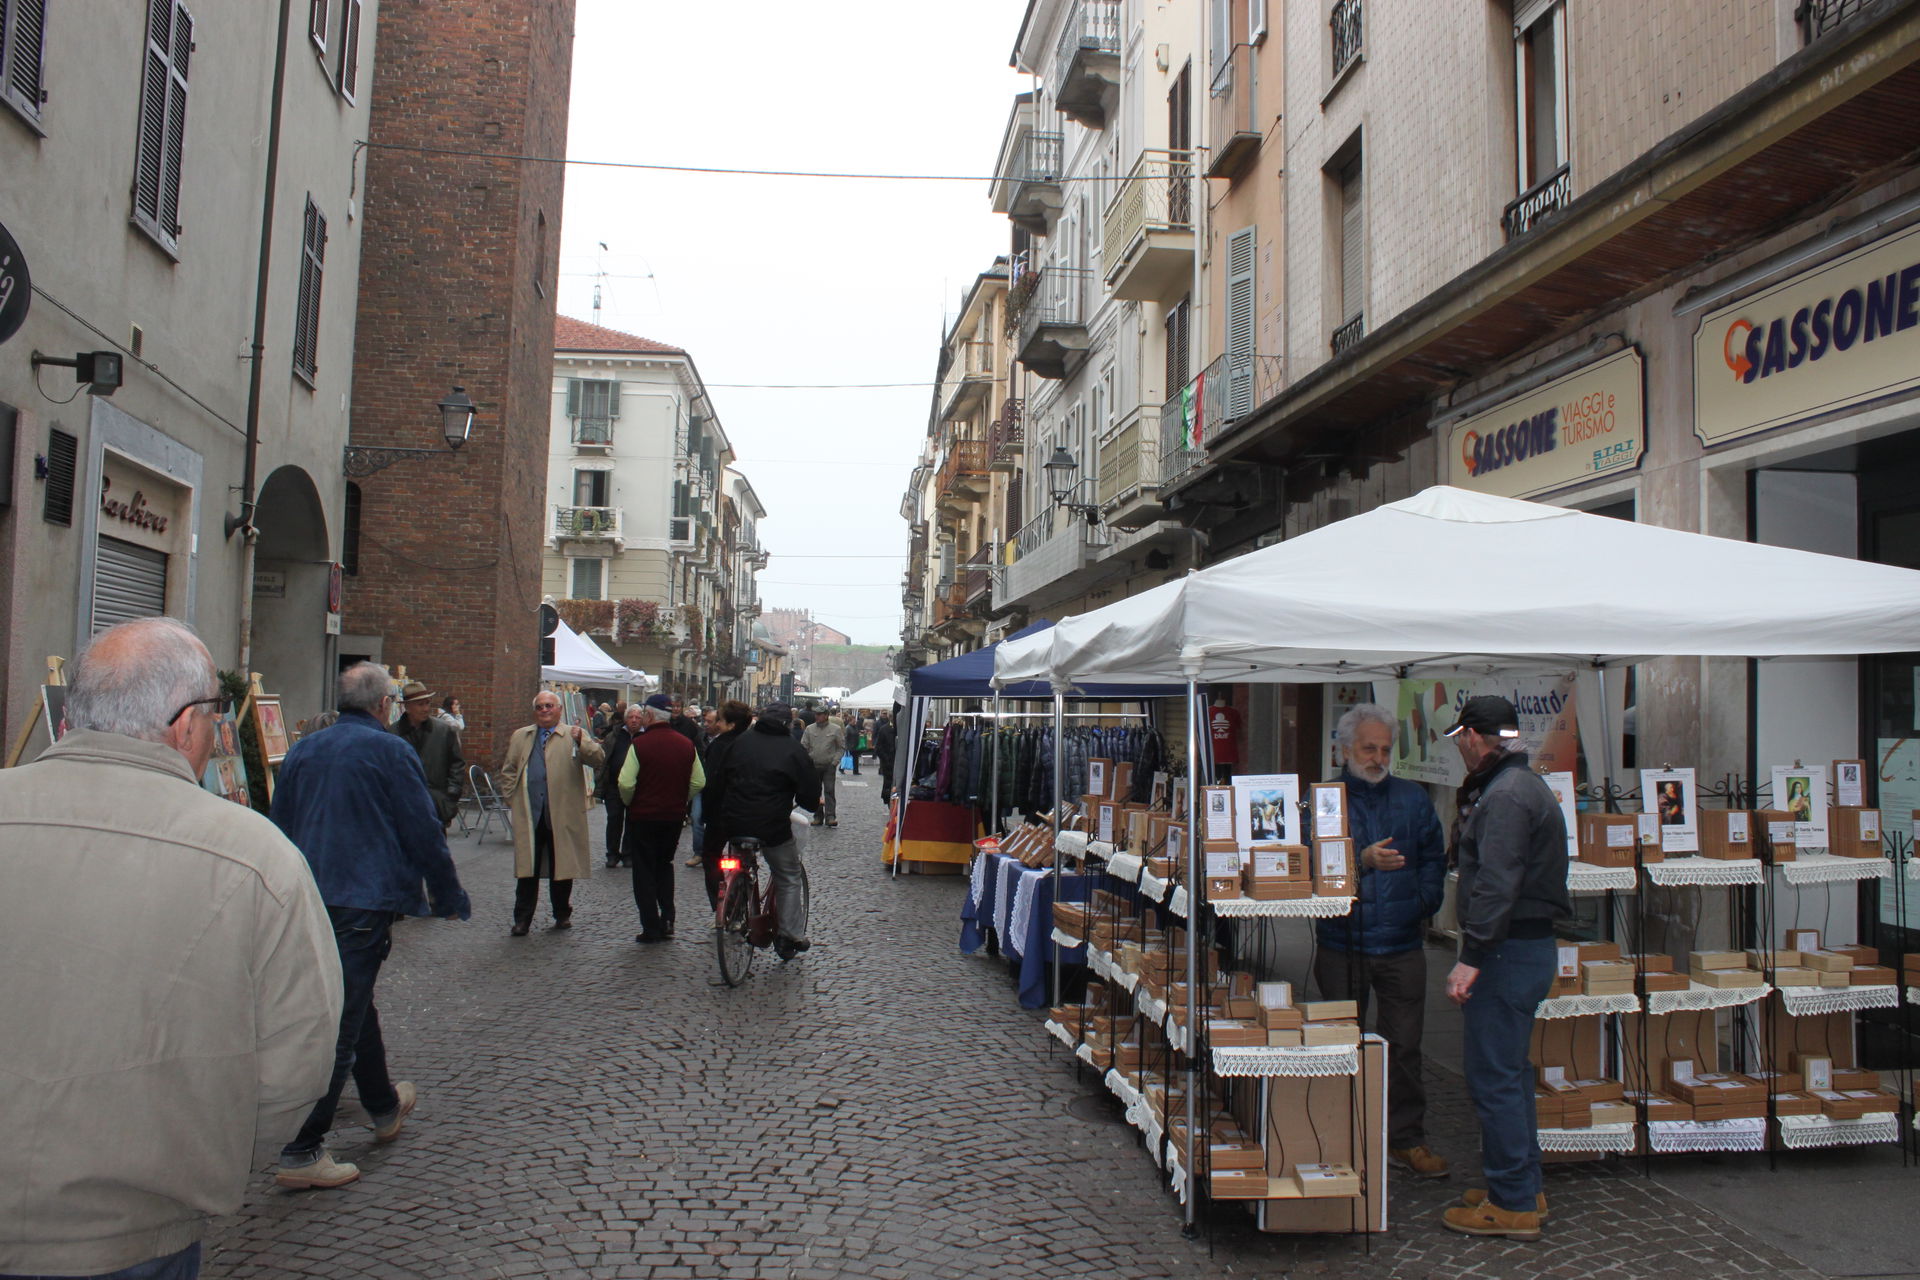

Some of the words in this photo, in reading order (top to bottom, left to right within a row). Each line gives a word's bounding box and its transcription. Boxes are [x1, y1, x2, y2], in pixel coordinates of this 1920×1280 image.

[1743, 263, 1920, 384] SASSONE
[1561, 391, 1605, 422] VIAGGI
[1607, 393, 1616, 408] e
[1562, 409, 1616, 447] TURISMO
[1472, 406, 1559, 477] SASSONE
